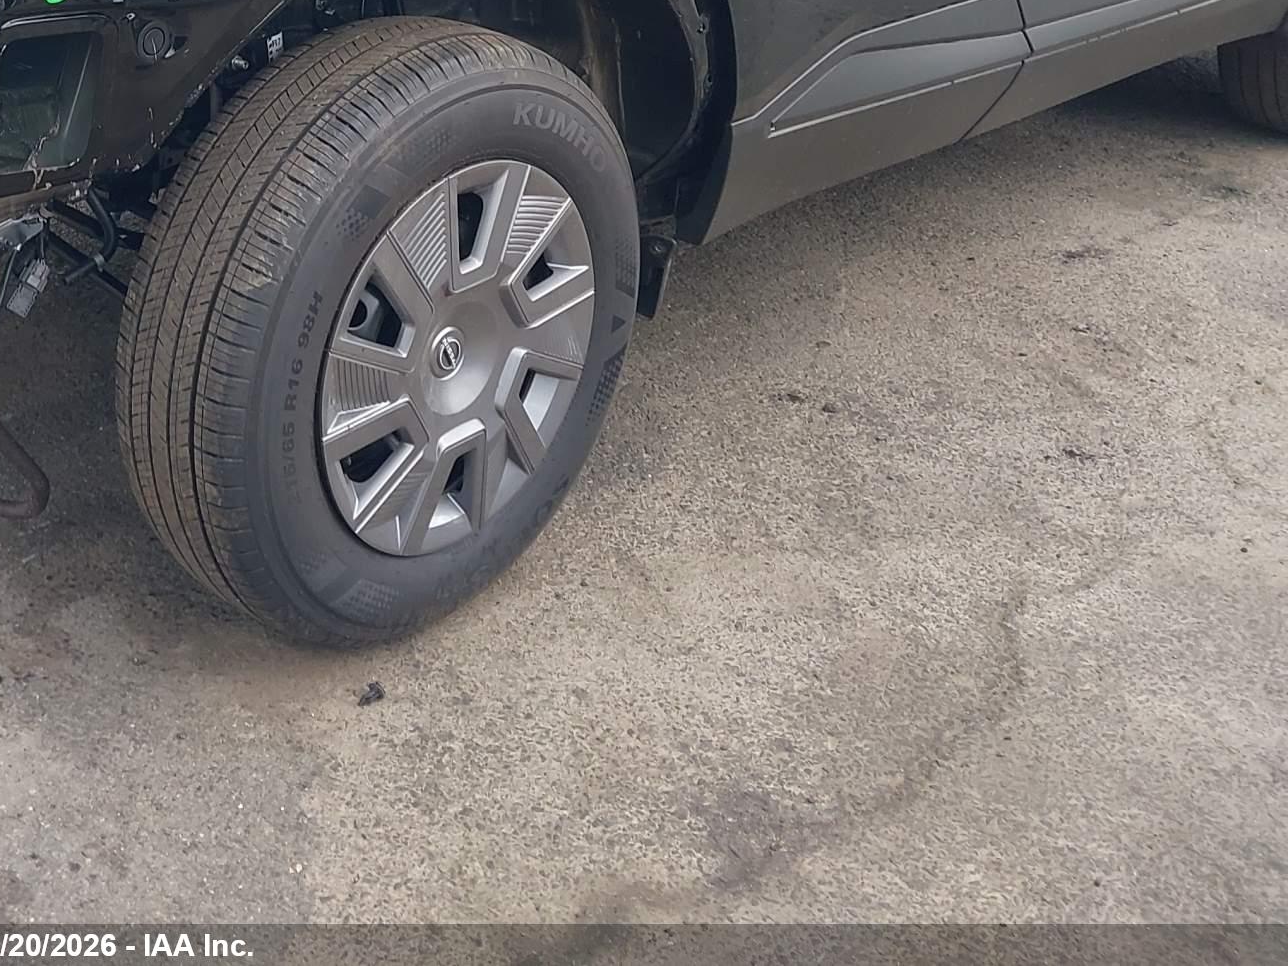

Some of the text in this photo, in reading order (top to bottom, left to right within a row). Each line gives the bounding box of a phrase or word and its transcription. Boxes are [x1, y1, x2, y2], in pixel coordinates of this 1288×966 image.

[513, 102, 607, 172] KUMHO
[284, 358, 303, 411] R16
[298, 291, 323, 349] 98H
